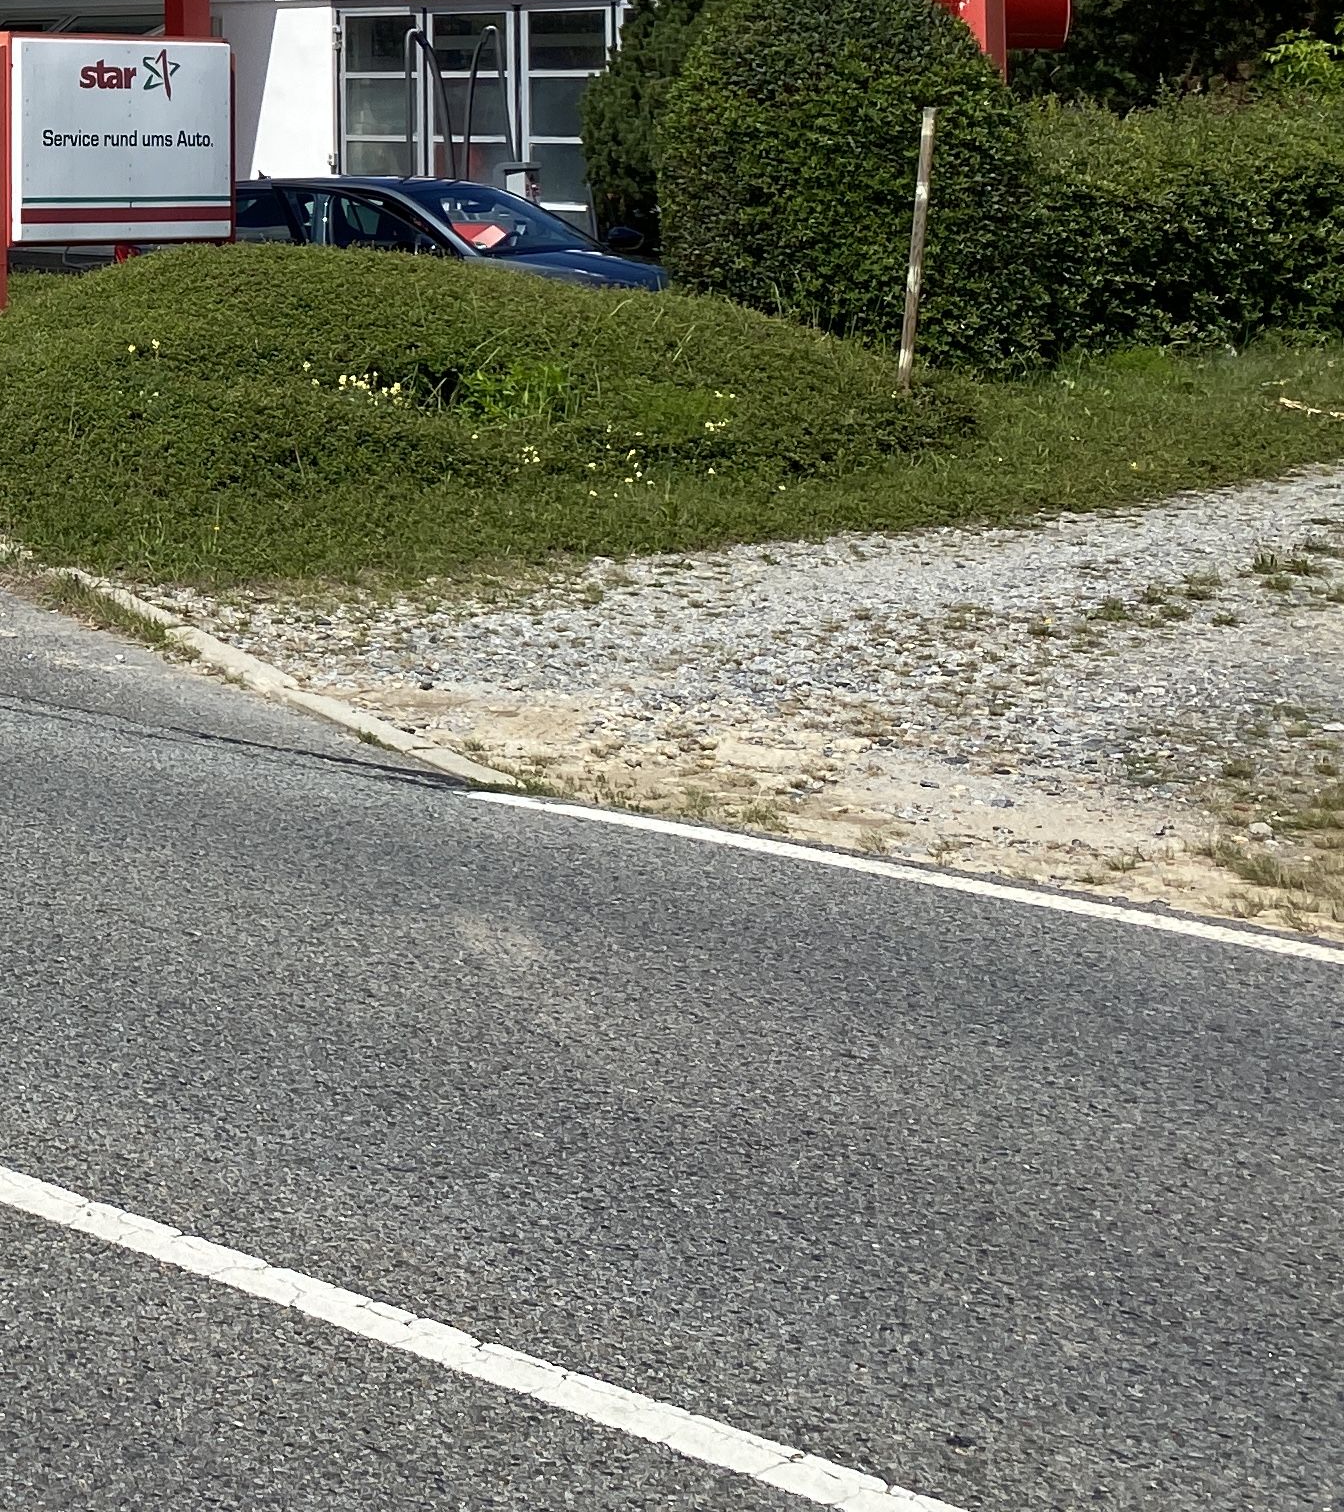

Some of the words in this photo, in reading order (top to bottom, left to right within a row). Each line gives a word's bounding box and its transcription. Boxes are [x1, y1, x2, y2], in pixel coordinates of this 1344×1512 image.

[79, 59, 137, 89] star
[42, 128, 99, 148] Service
[104, 129, 138, 147] rund
[142, 133, 173, 148] ums
[176, 129, 214, 148] Auto.
